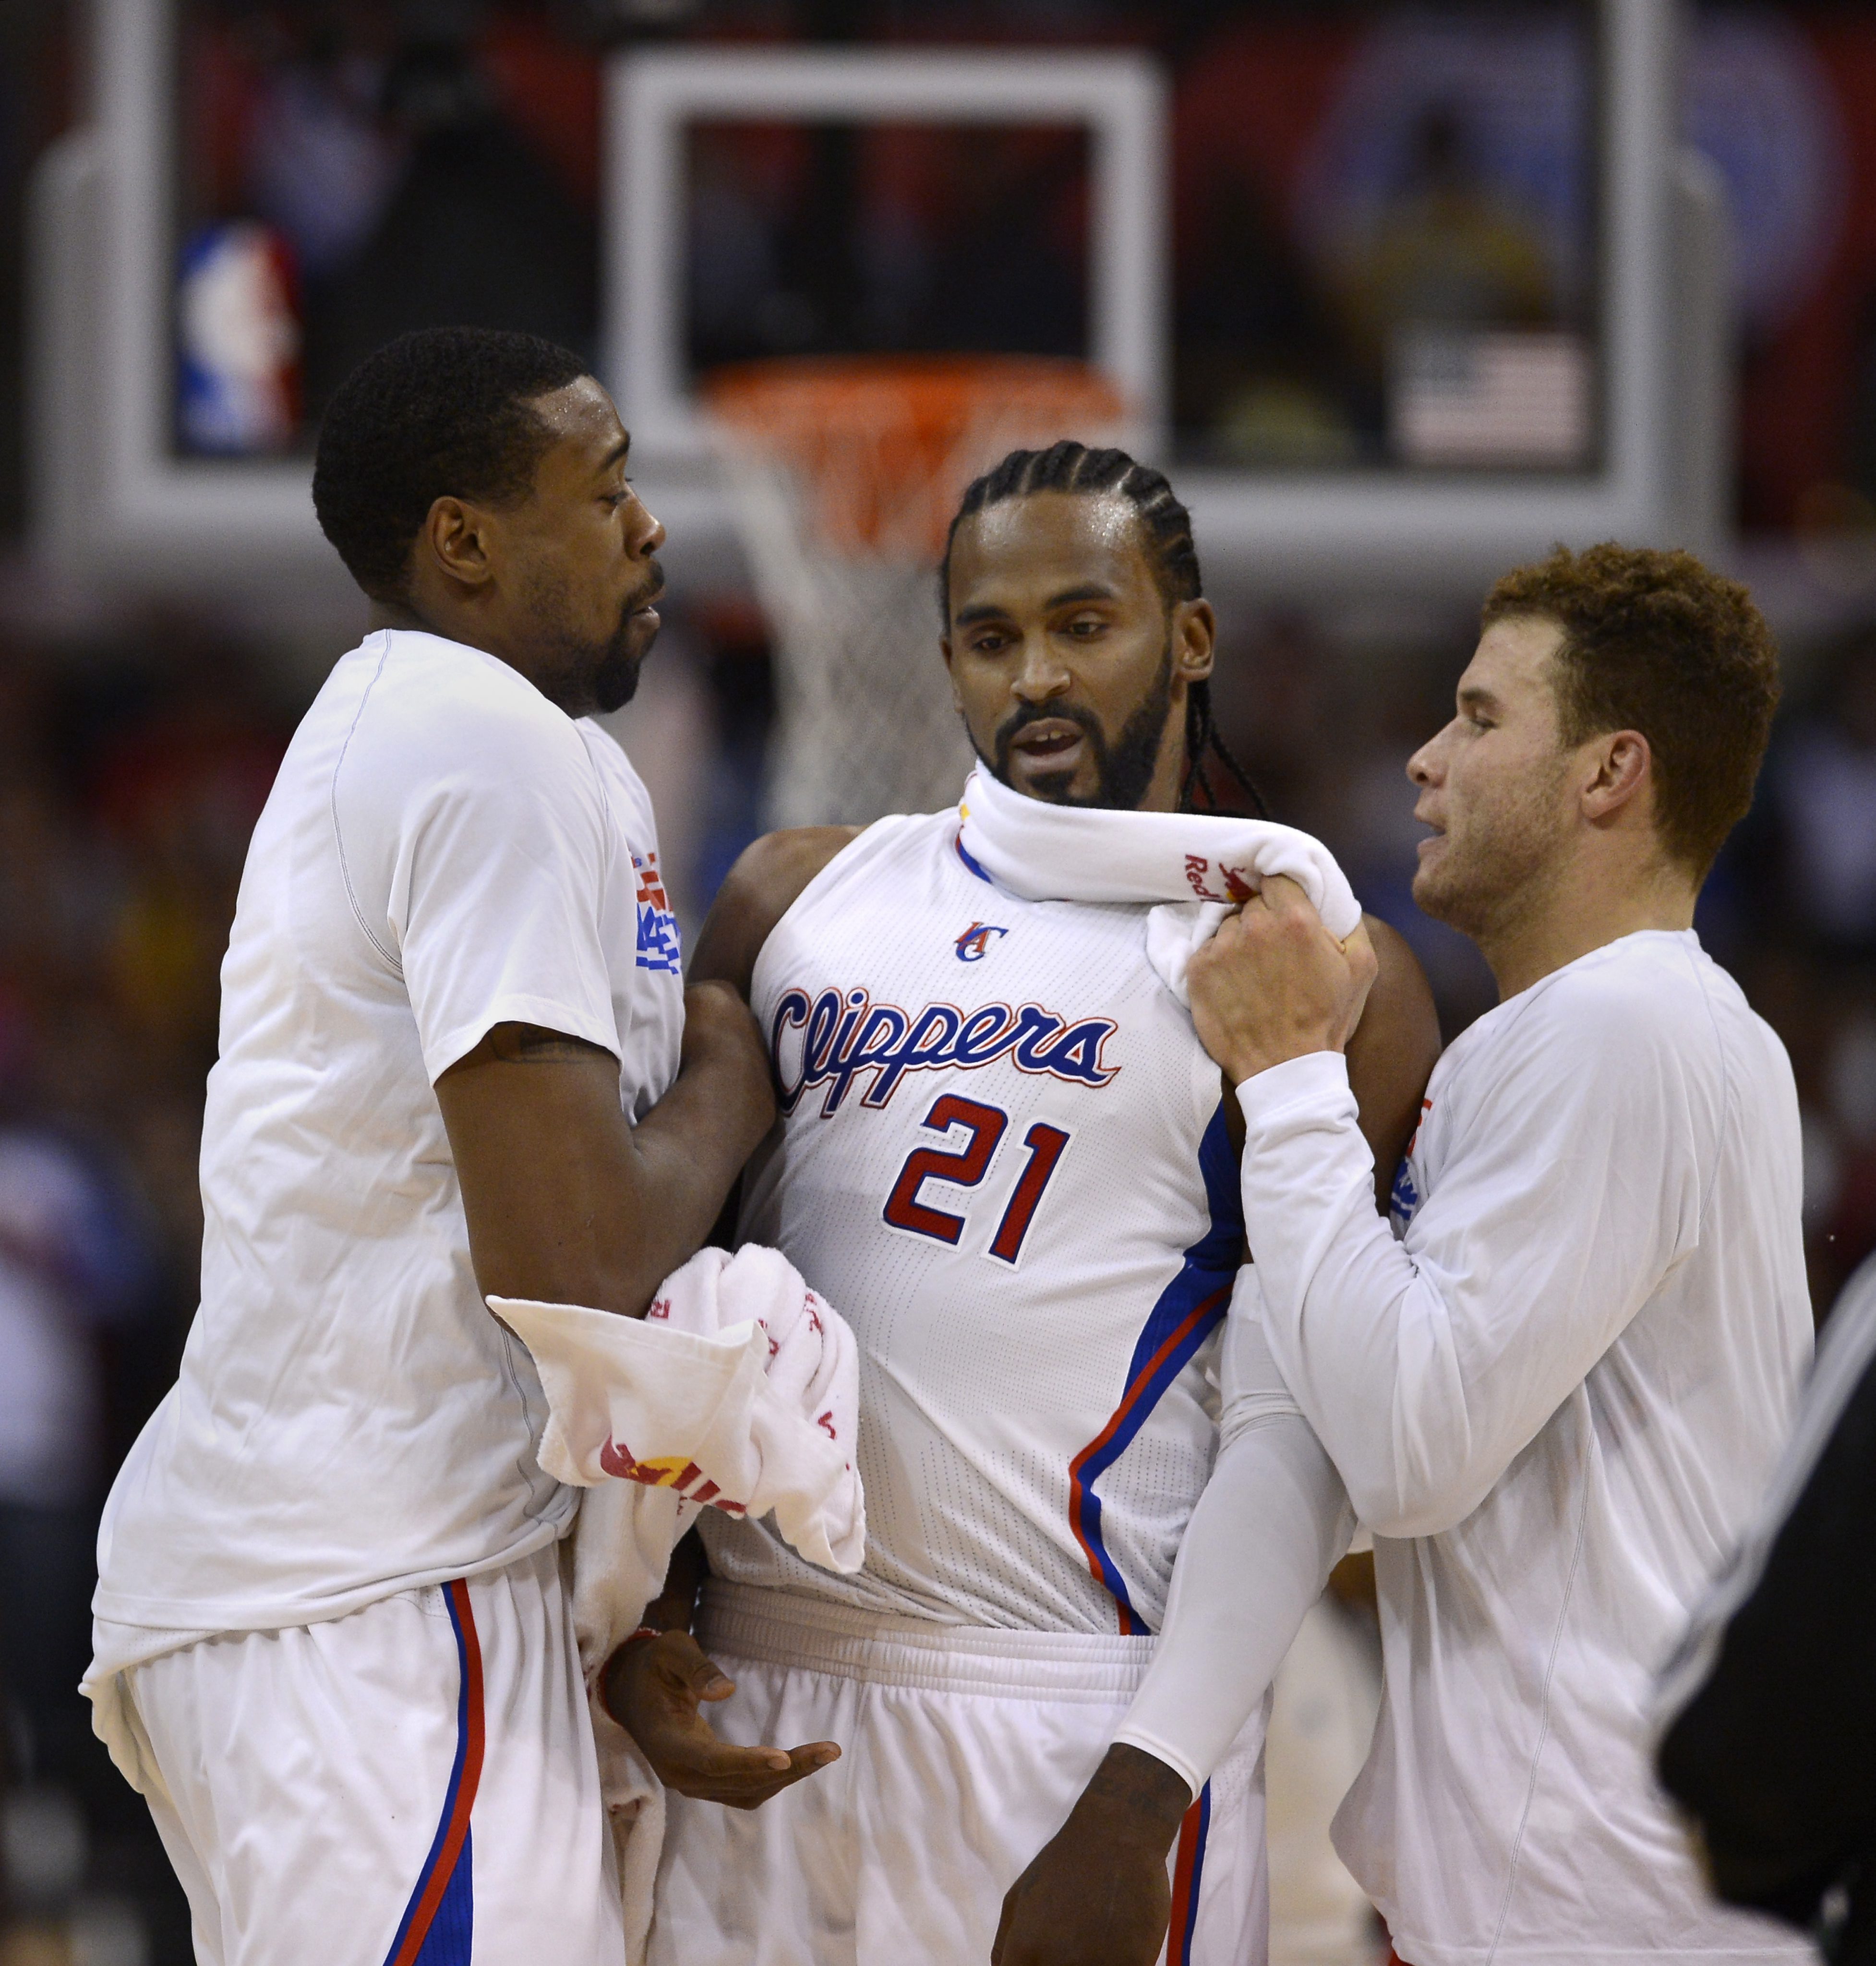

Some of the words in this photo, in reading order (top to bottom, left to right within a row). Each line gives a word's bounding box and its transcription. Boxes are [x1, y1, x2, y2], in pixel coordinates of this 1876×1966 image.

[1185, 854, 1220, 898] Red
[771, 986, 1121, 1119] Clippers
[882, 1093, 1071, 1265] 21
